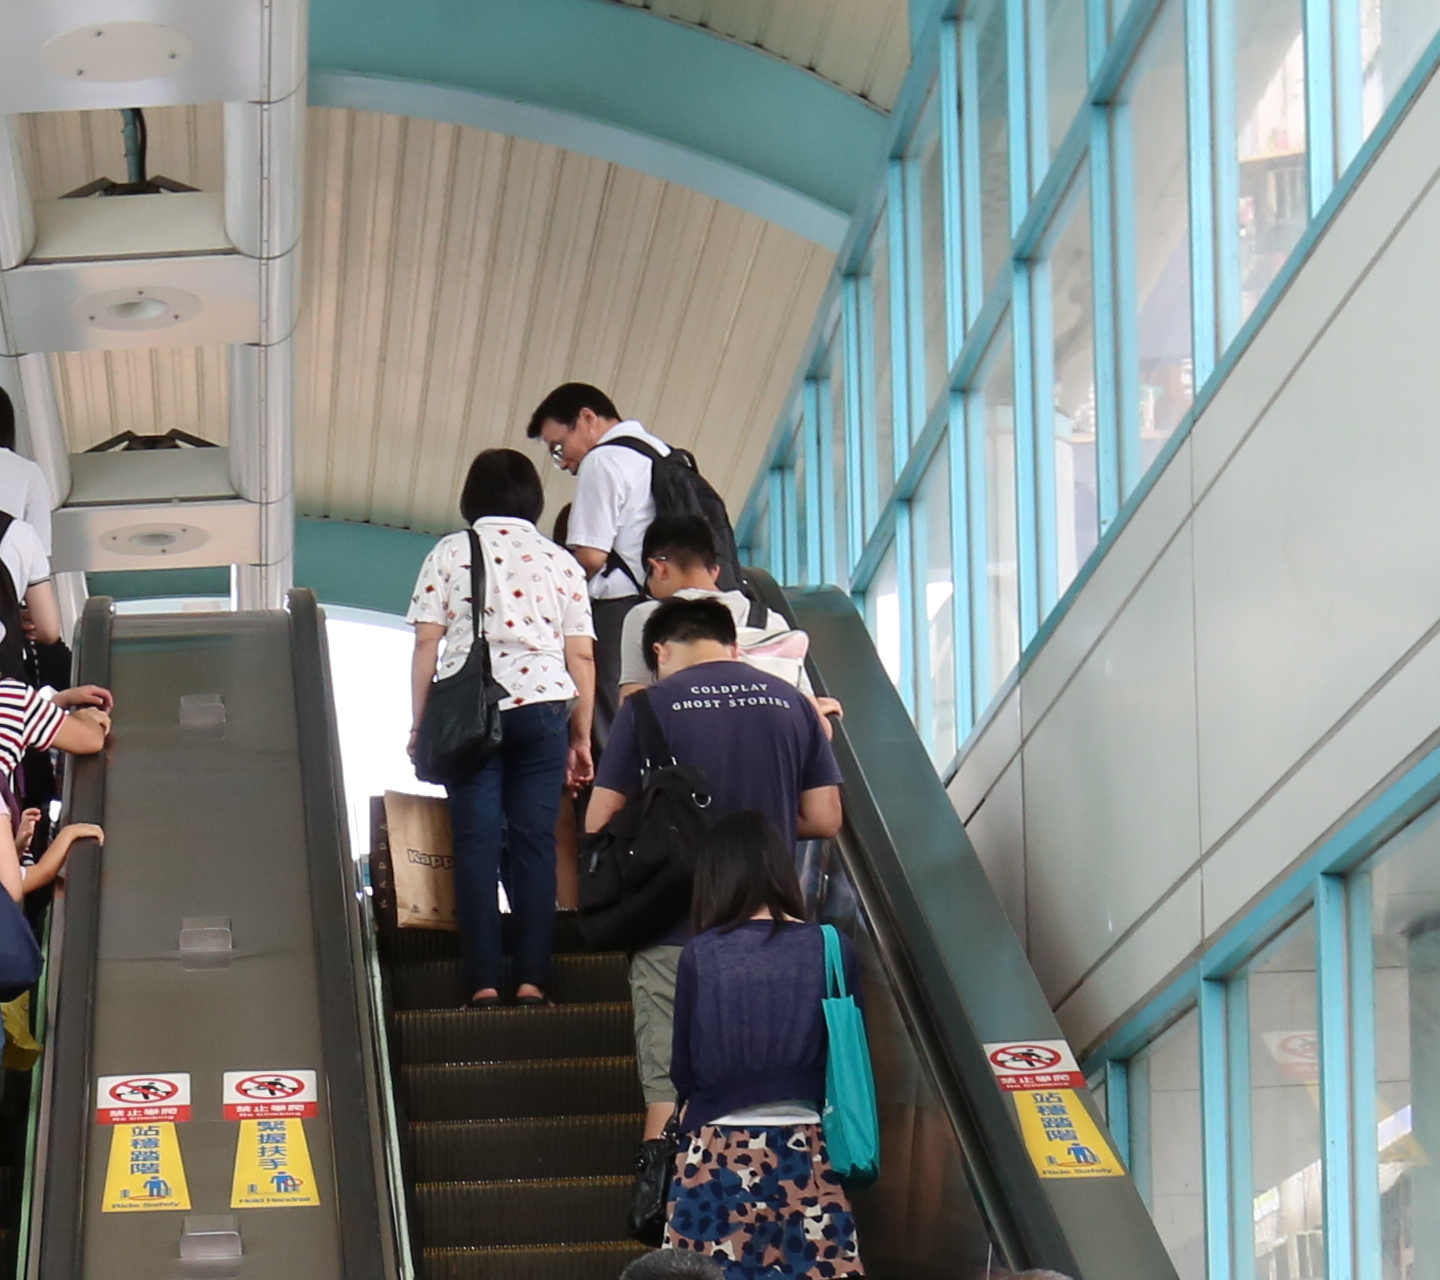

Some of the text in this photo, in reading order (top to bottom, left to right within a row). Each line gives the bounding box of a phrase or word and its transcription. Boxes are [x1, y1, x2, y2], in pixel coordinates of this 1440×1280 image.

[672, 697, 791, 711] GHOST STORIES
[691, 684, 768, 695] COLDPLAY
[130, 1126, 161, 1175] 站穩踏階
[257, 1121, 288, 1171] 緊握扶手
